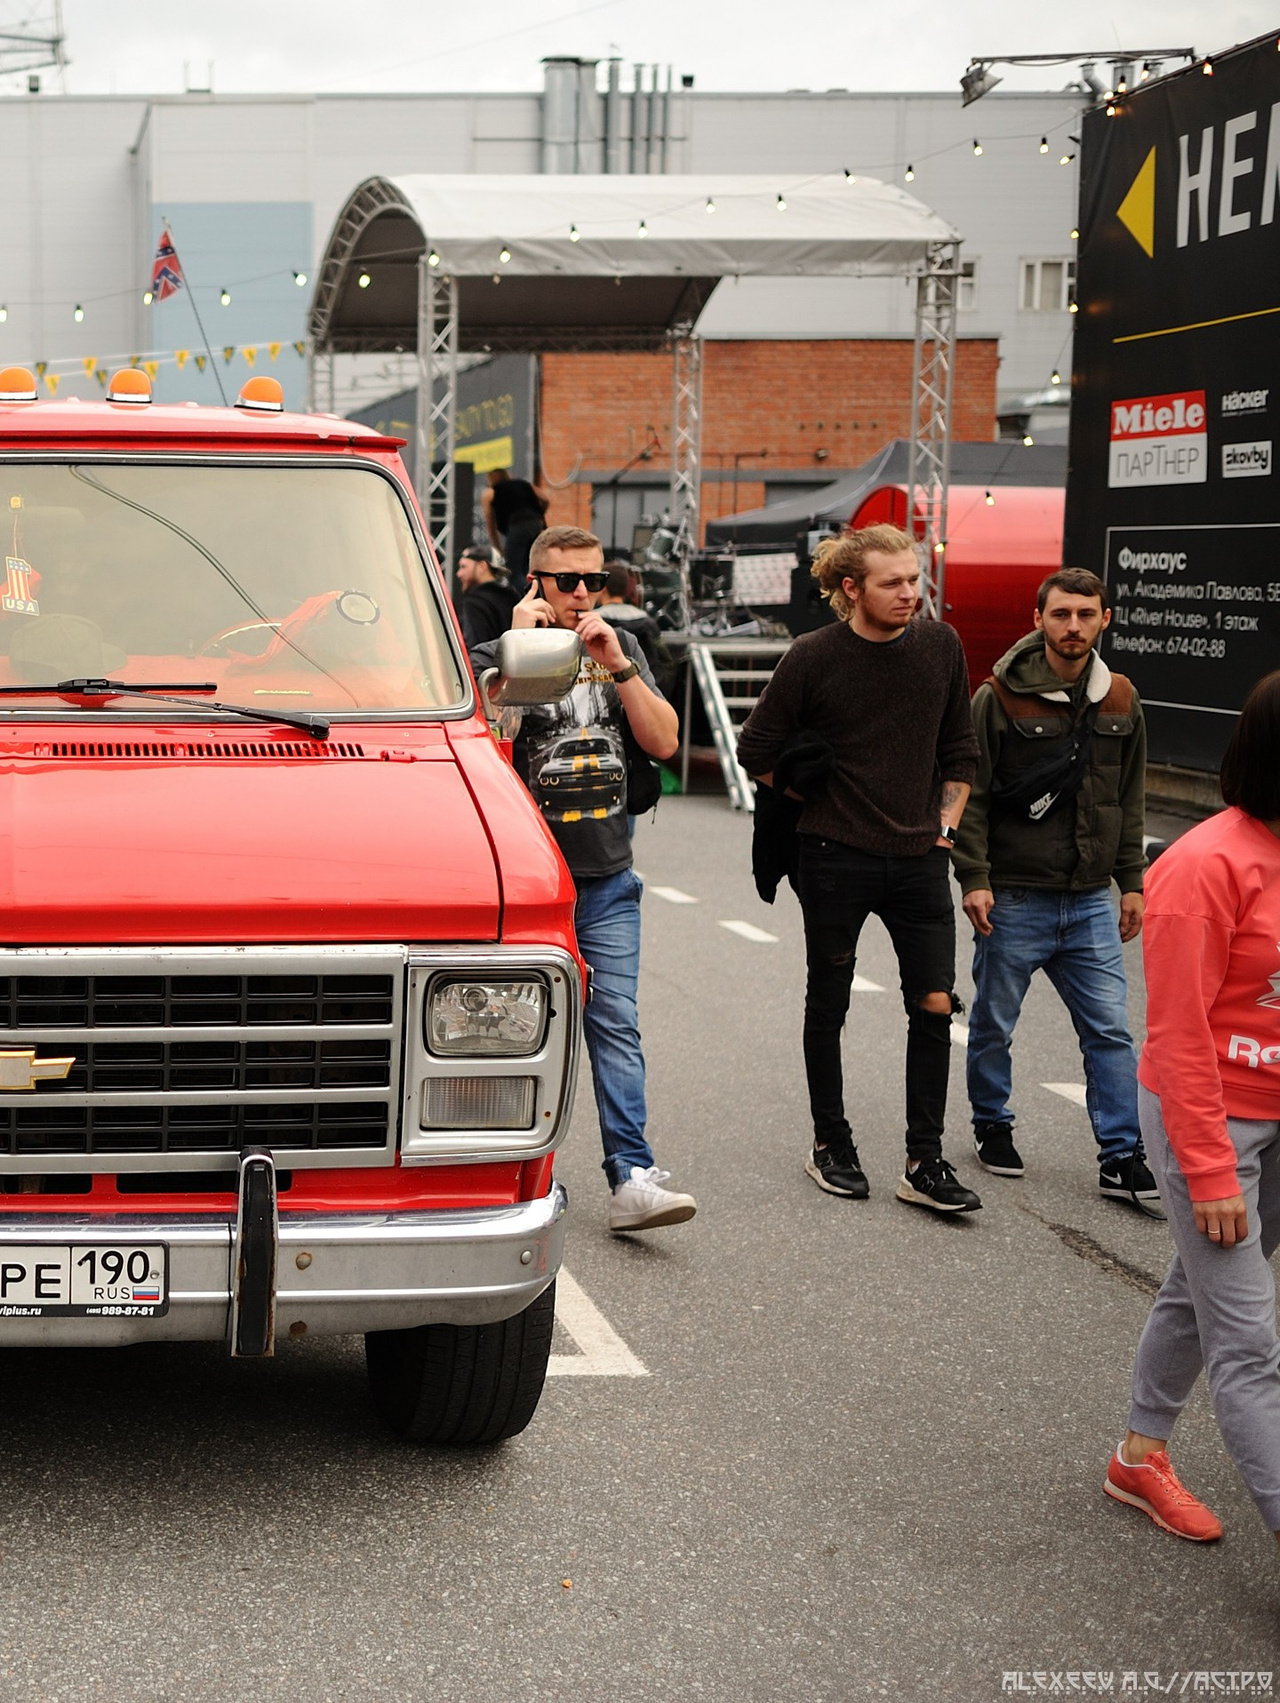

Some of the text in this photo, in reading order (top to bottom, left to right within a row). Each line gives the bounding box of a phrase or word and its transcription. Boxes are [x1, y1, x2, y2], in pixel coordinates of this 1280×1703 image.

[1113, 399, 1205, 435] Miele
[1116, 445, 1199, 478] ПАРТНЕР
[1118, 546, 1187, 574] Фирхаус
[1134, 580, 1204, 600] Академика
[1206, 581, 1265, 602] Павлова,
[6, 598, 35, 612] USA
[1114, 606, 1129, 626] ТЦ
[1215, 611, 1222, 629] 1
[1224, 616, 1259, 631] этаж
[1111, 632, 1226, 659] Телефон: 674-02-88
[1030, 792, 1052, 815] NIKE
[77, 1250, 151, 1285] 190
[94, 1287, 131, 1300] RUS
[101, 1305, 155, 1316] 989-87-81
